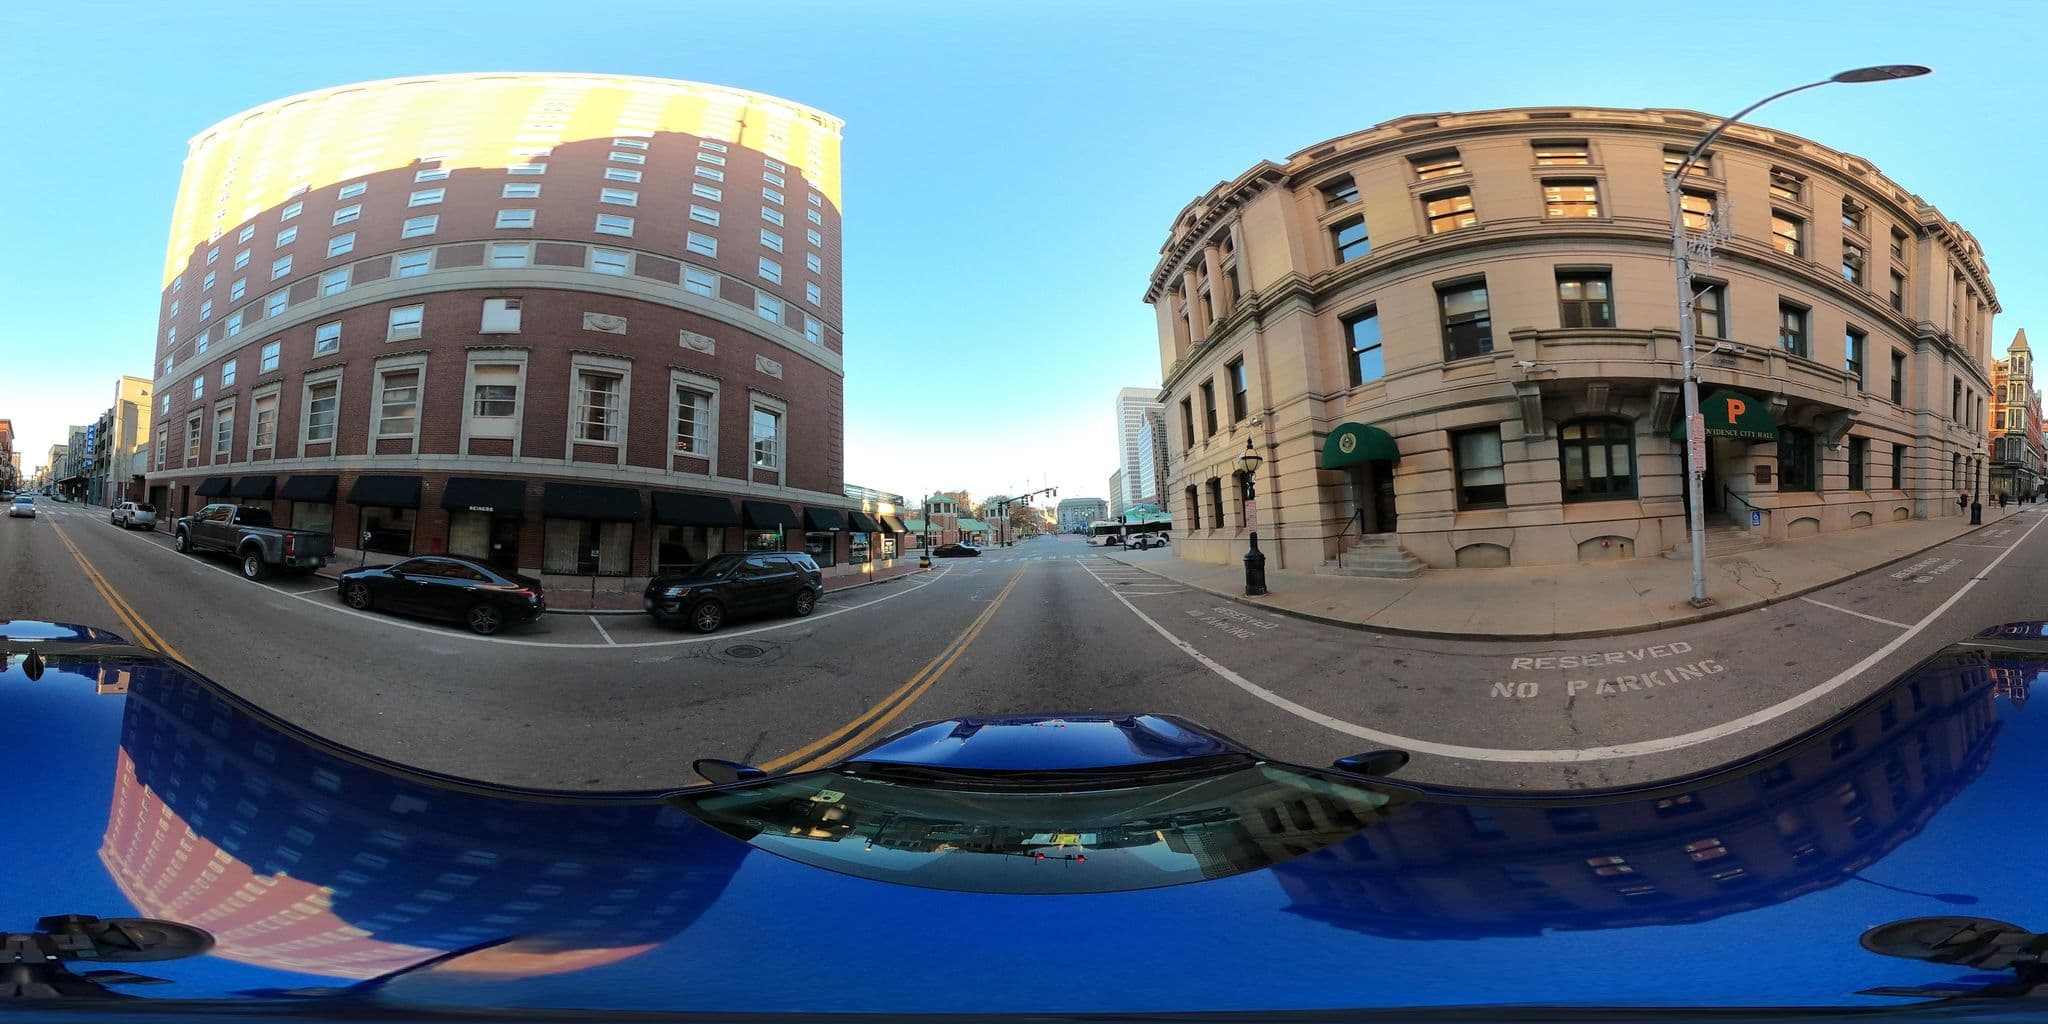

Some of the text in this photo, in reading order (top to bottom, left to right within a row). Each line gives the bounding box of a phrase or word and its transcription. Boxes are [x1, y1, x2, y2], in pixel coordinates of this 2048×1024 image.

[1726, 398, 1746, 424] P
[1757, 431, 1774, 439] HALL
[1510, 641, 1694, 670] RESERVED
[1490, 658, 1724, 699] NO PARKING
